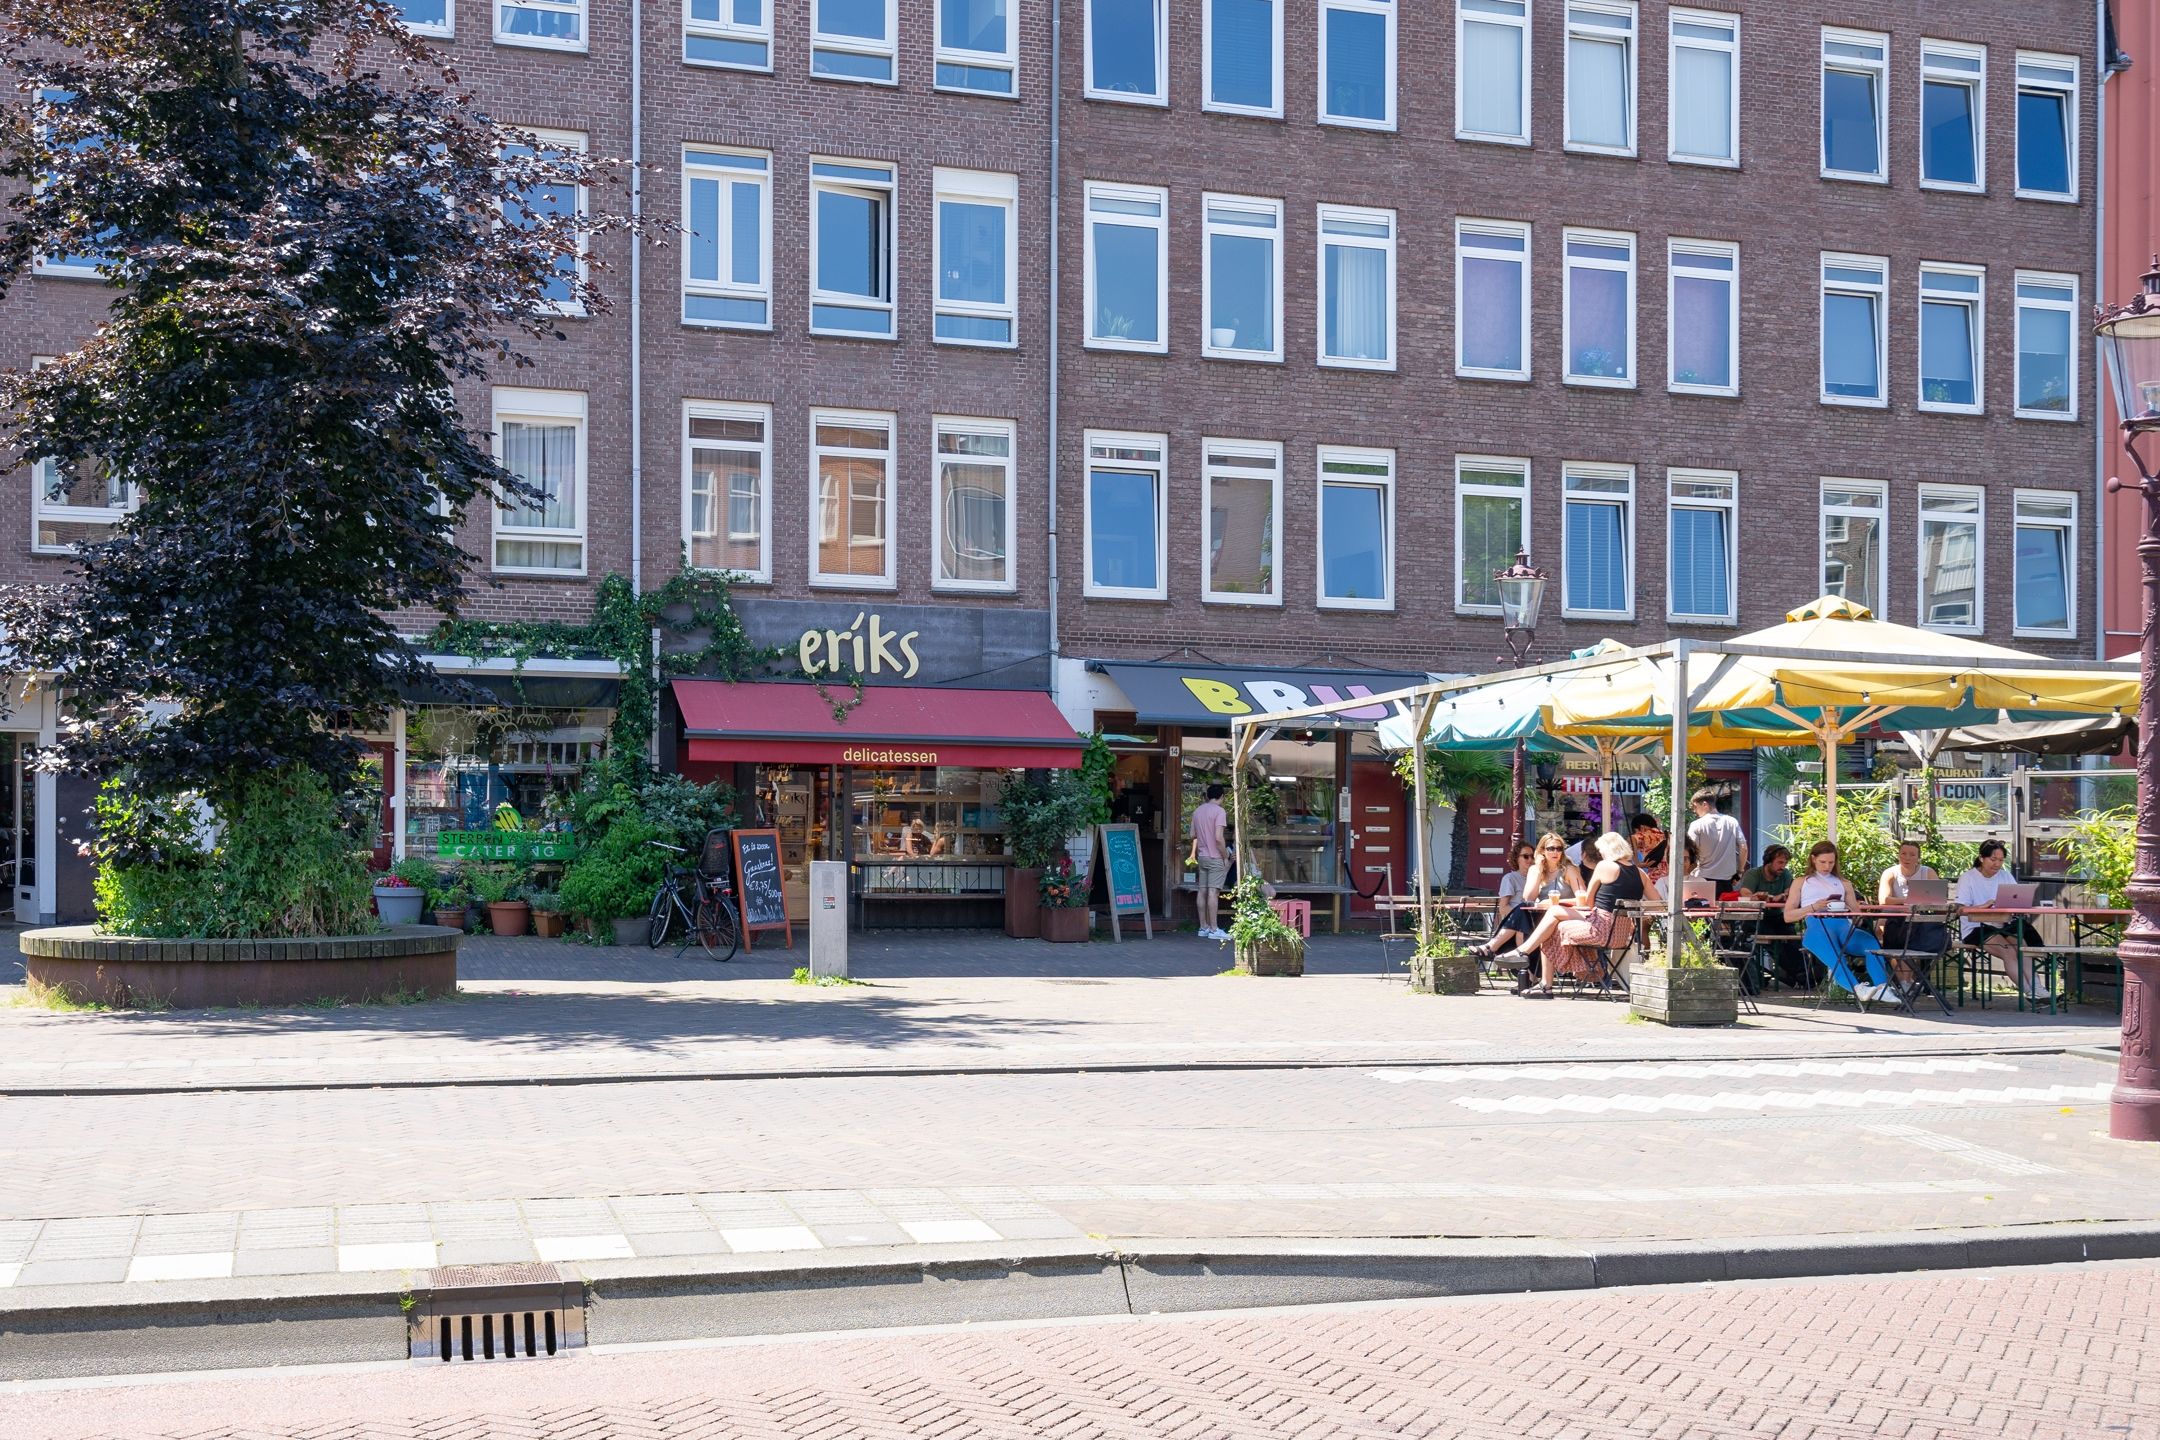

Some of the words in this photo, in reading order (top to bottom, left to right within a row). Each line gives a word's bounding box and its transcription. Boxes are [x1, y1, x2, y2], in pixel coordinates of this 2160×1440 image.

[1180, 676, 1390, 720] BRU
[843, 747, 937, 763] delicatessen
[1171, 747, 1178, 755] 14
[455, 845, 555, 857] CATERNG
